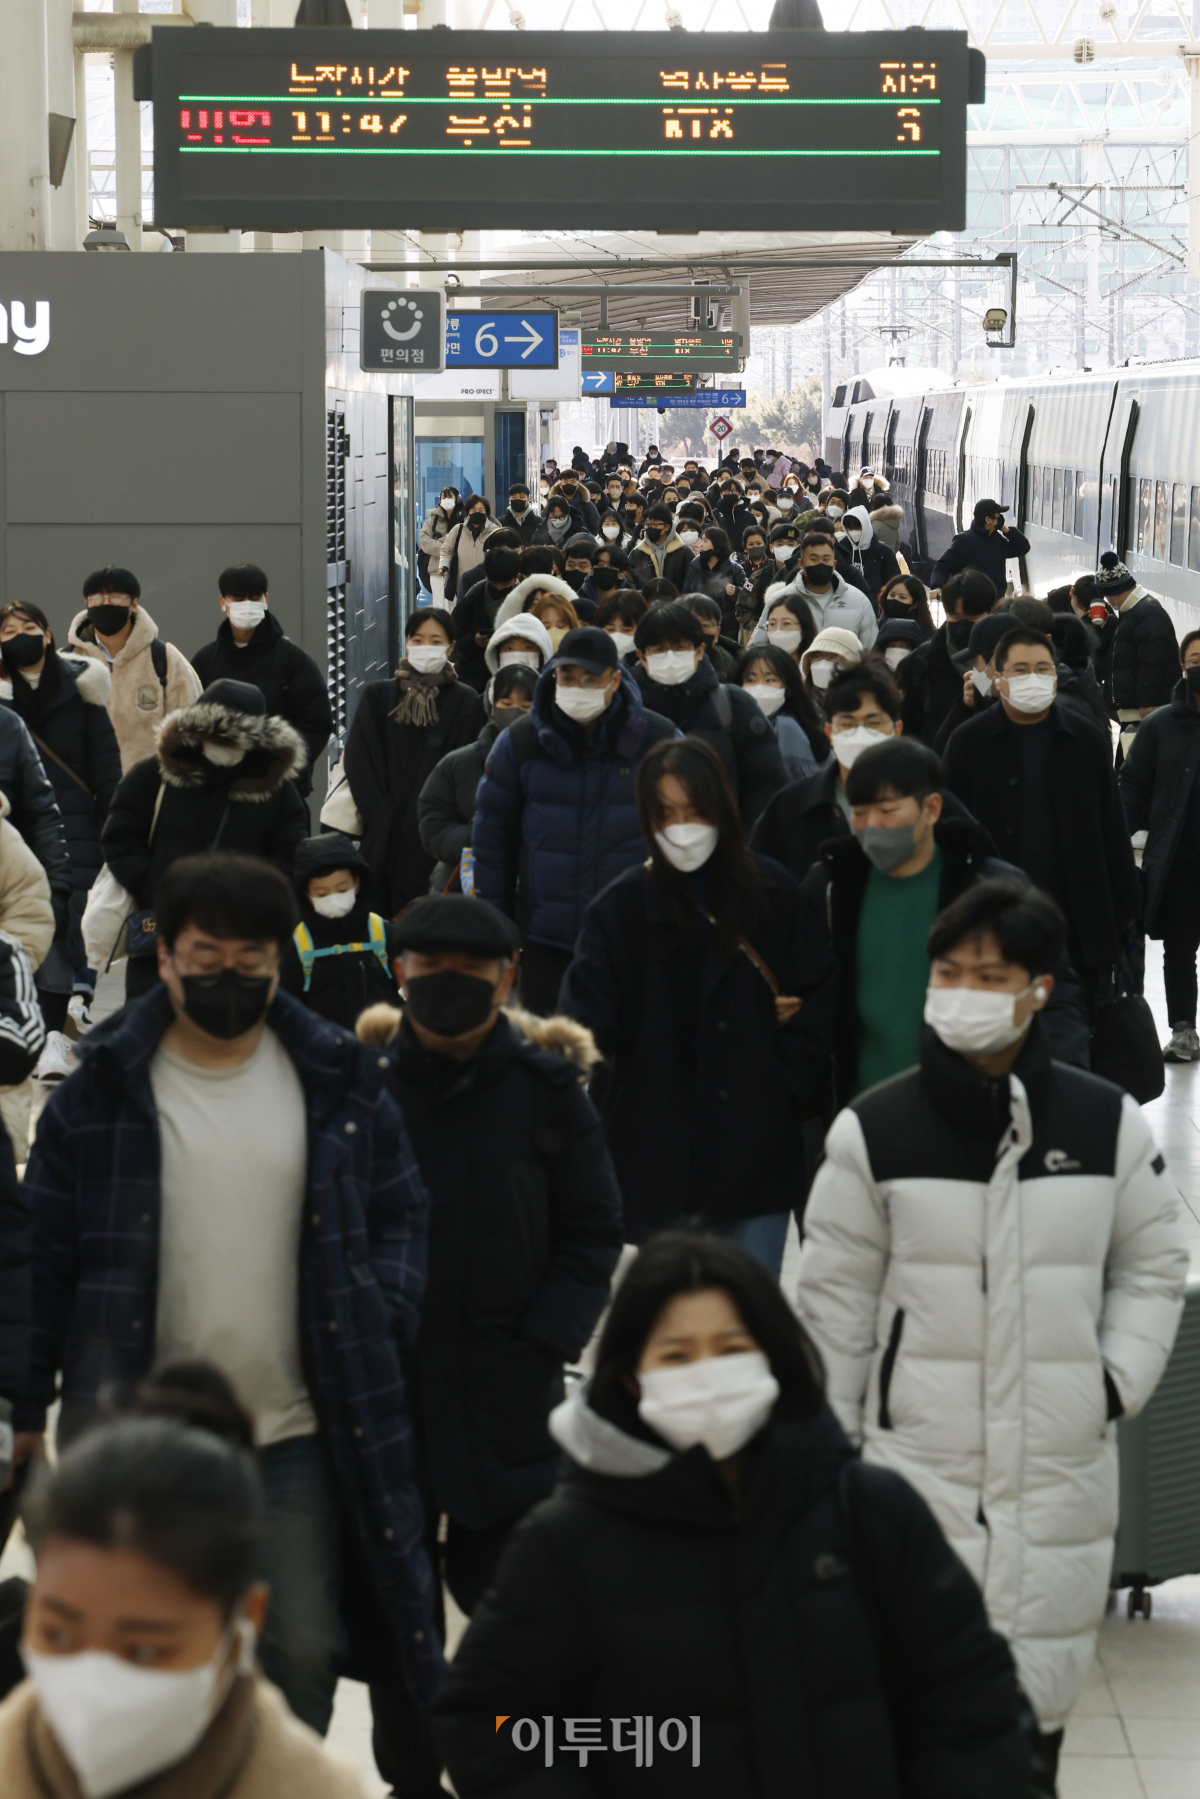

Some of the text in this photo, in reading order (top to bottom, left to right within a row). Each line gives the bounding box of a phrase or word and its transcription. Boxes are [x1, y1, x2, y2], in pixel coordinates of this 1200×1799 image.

[0, 300, 50, 355] y
[475, 322, 498, 357] 6
[380, 348, 425, 364] 편의점
[721, 393, 729, 404] 6
[716, 425, 726, 433] 20
